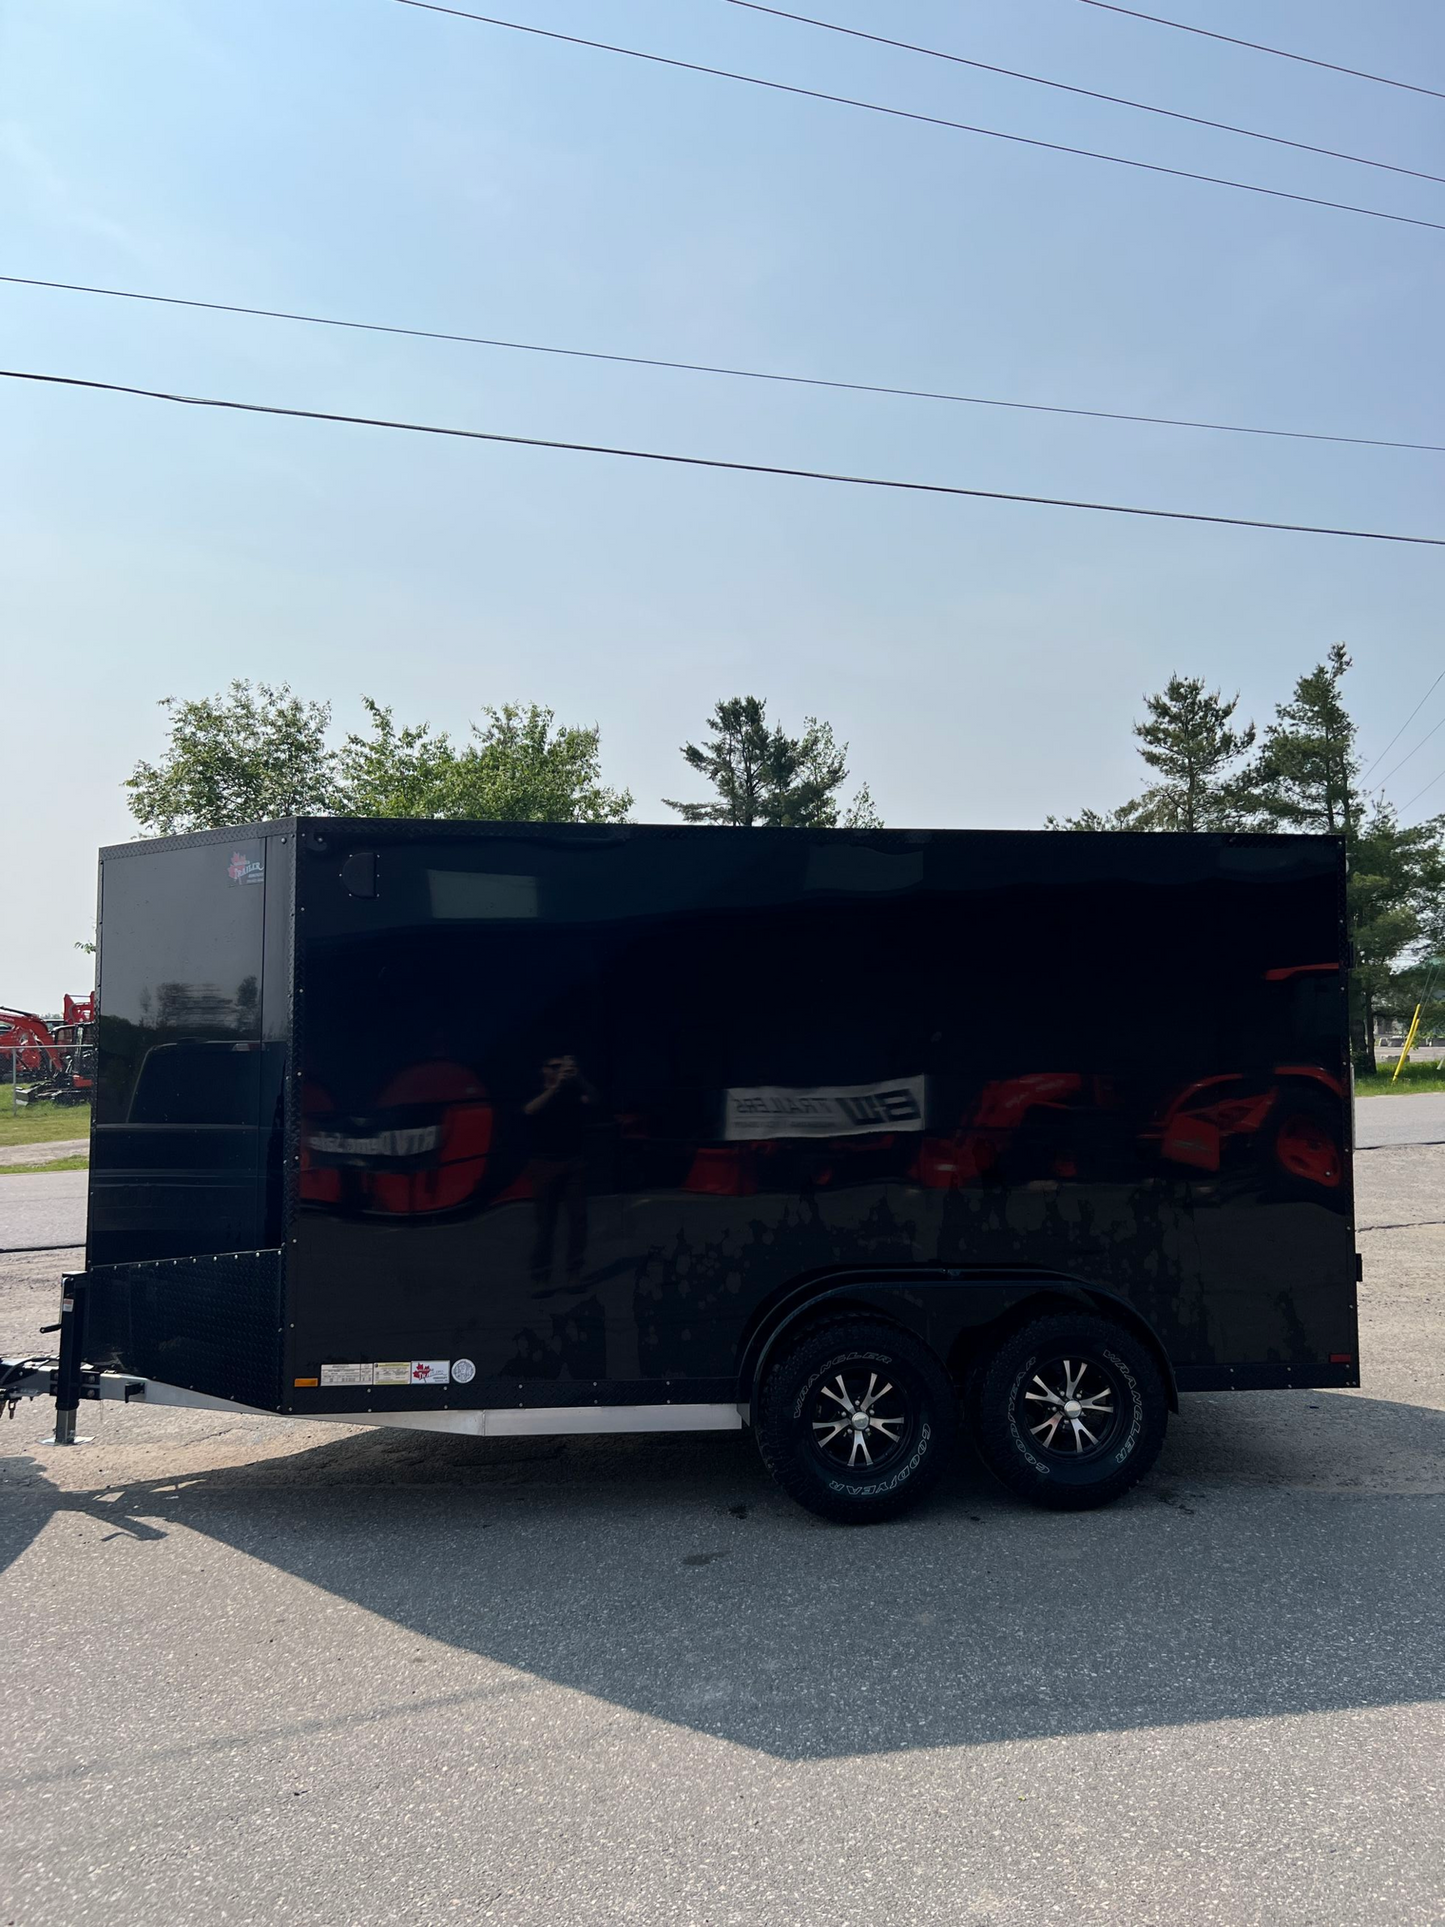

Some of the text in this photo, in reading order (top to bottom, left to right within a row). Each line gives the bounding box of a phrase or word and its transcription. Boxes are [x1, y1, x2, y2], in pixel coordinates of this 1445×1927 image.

[793, 1351, 892, 1419] WRANGLER
[1007, 1356, 1050, 1474] GOODYEAR
[1102, 1349, 1143, 1464] WRANGLER
[828, 1422, 932, 1495] GOODYEAR
